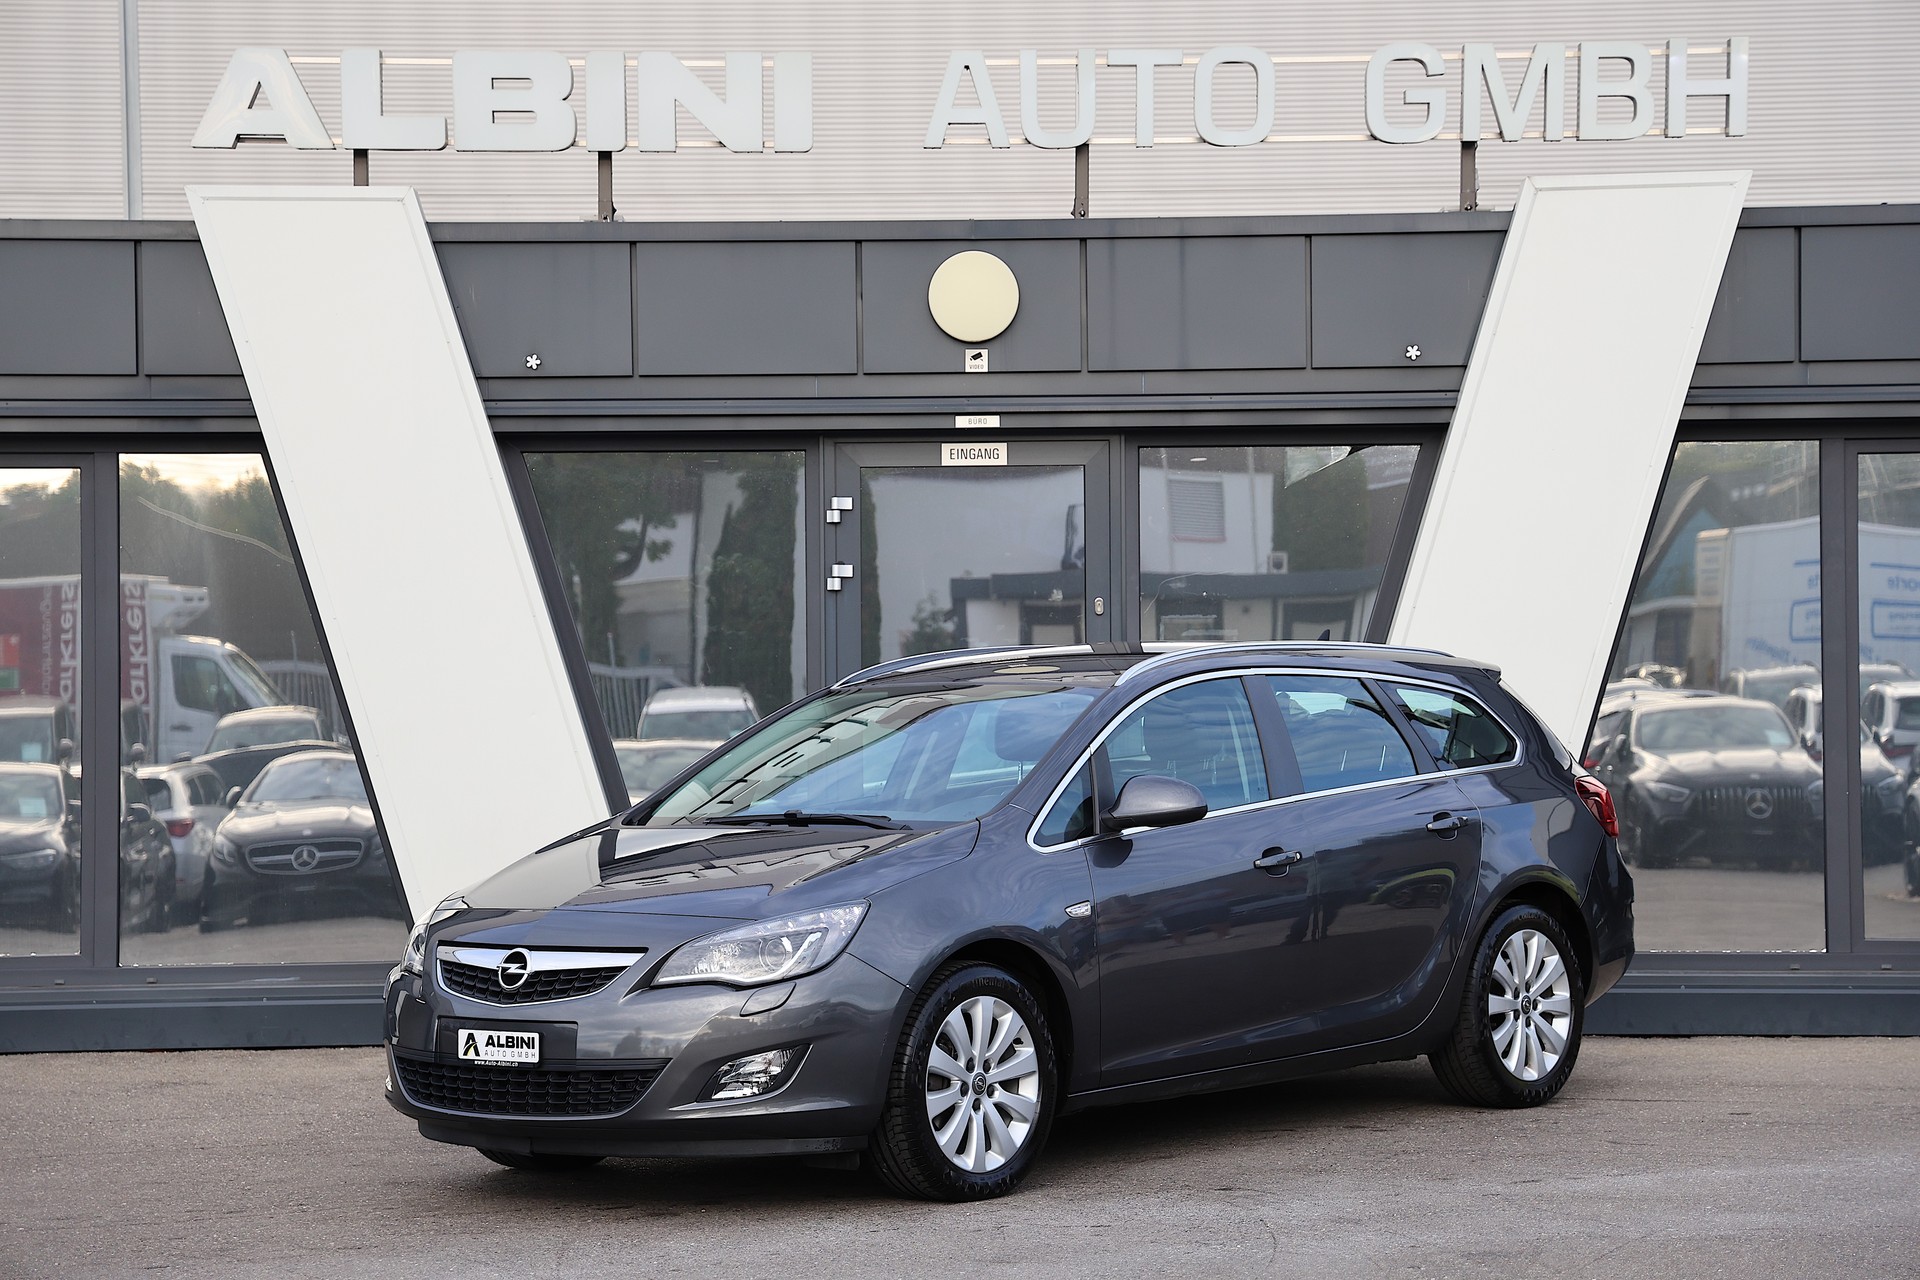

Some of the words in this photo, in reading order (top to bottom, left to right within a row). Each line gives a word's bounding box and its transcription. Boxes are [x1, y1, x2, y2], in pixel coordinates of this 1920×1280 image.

[191, 48, 813, 153] ALBINI
[924, 46, 1276, 149] AUTO
[1364, 37, 1749, 144] GMBH
[949, 447, 1000, 460] EINGANG
[485, 1035, 535, 1049] ALBINI
[484, 1050, 506, 1058] AUTO
[511, 1050, 536, 1059] GMBH
